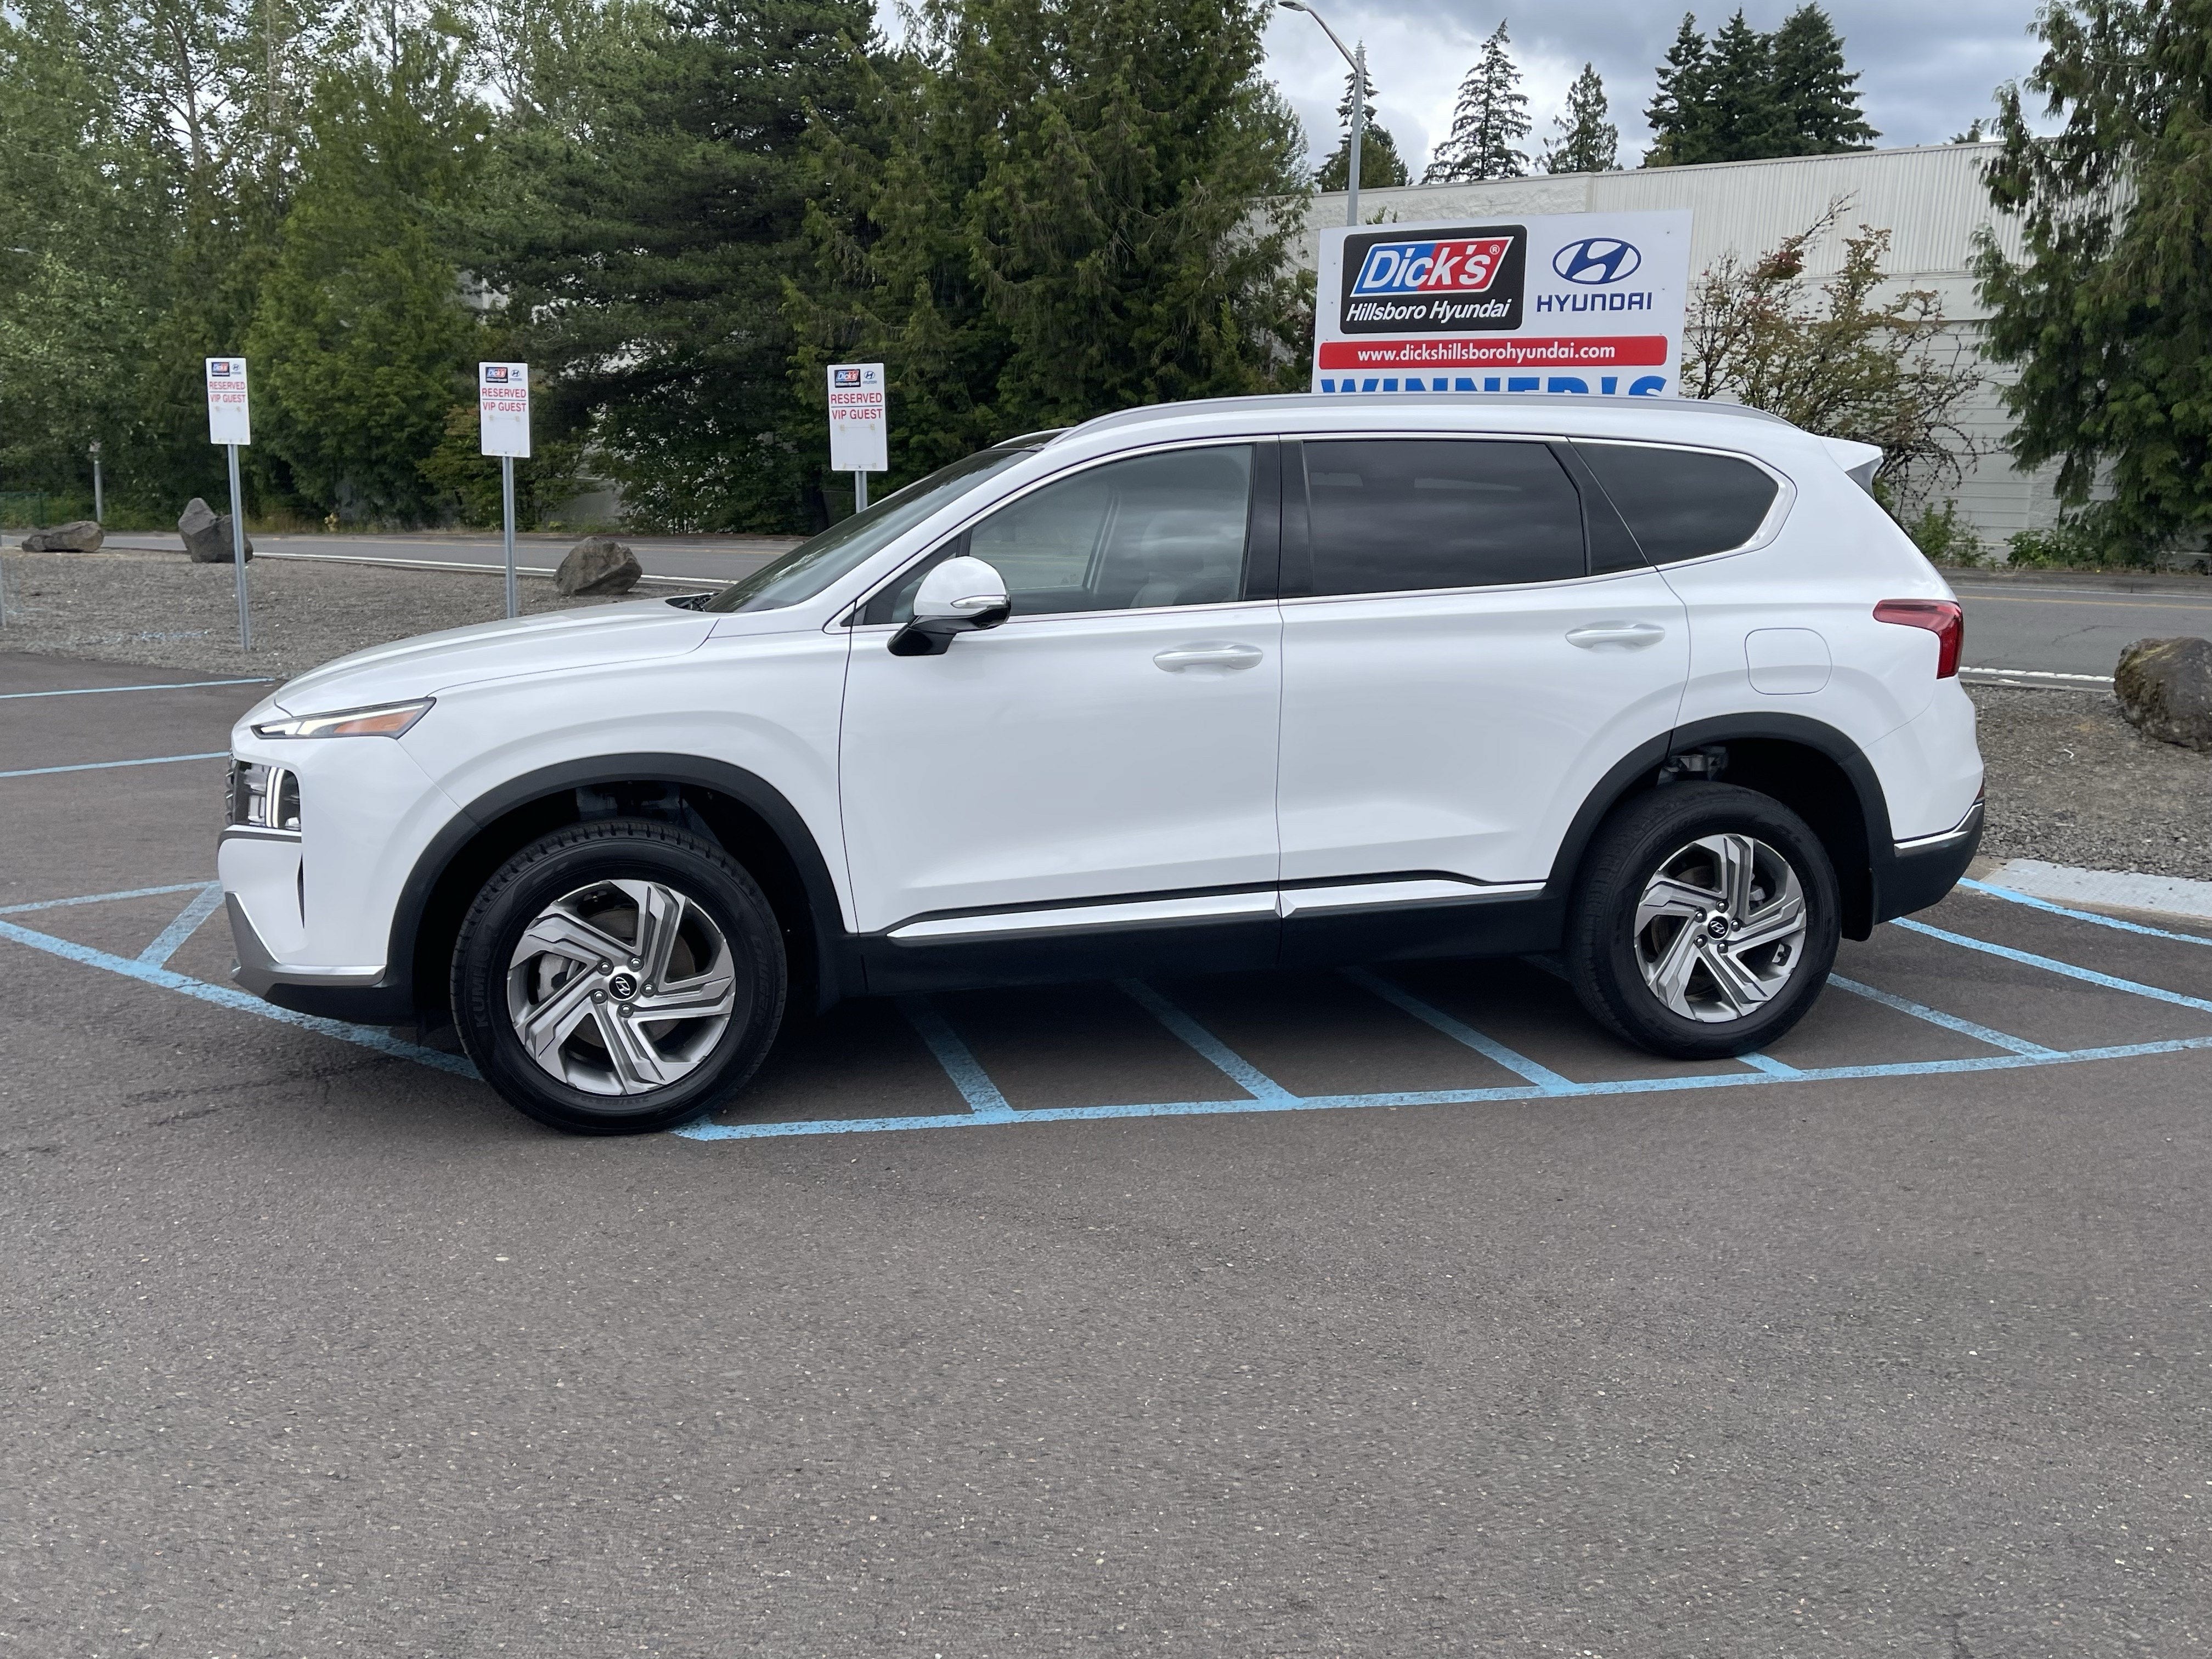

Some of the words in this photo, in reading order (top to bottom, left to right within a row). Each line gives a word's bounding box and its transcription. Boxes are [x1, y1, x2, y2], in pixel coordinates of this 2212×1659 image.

[1537, 292, 1652, 313] HYUNDAI
[1346, 302, 1427, 321] Hillsboro
[1429, 298, 1512, 324] Hyundai
[1357, 342, 1616, 364] www.dickshillsborohyundai.com
[209, 381, 245, 390] RESERVED
[222, 394, 246, 403] GUEST
[482, 388, 526, 398] RESERVED
[830, 393, 882, 404] RESERVED
[483, 402, 496, 411] VIP
[498, 402, 526, 412] GUEST
[832, 409, 847, 420] VIP
[850, 408, 883, 419] GUEST
